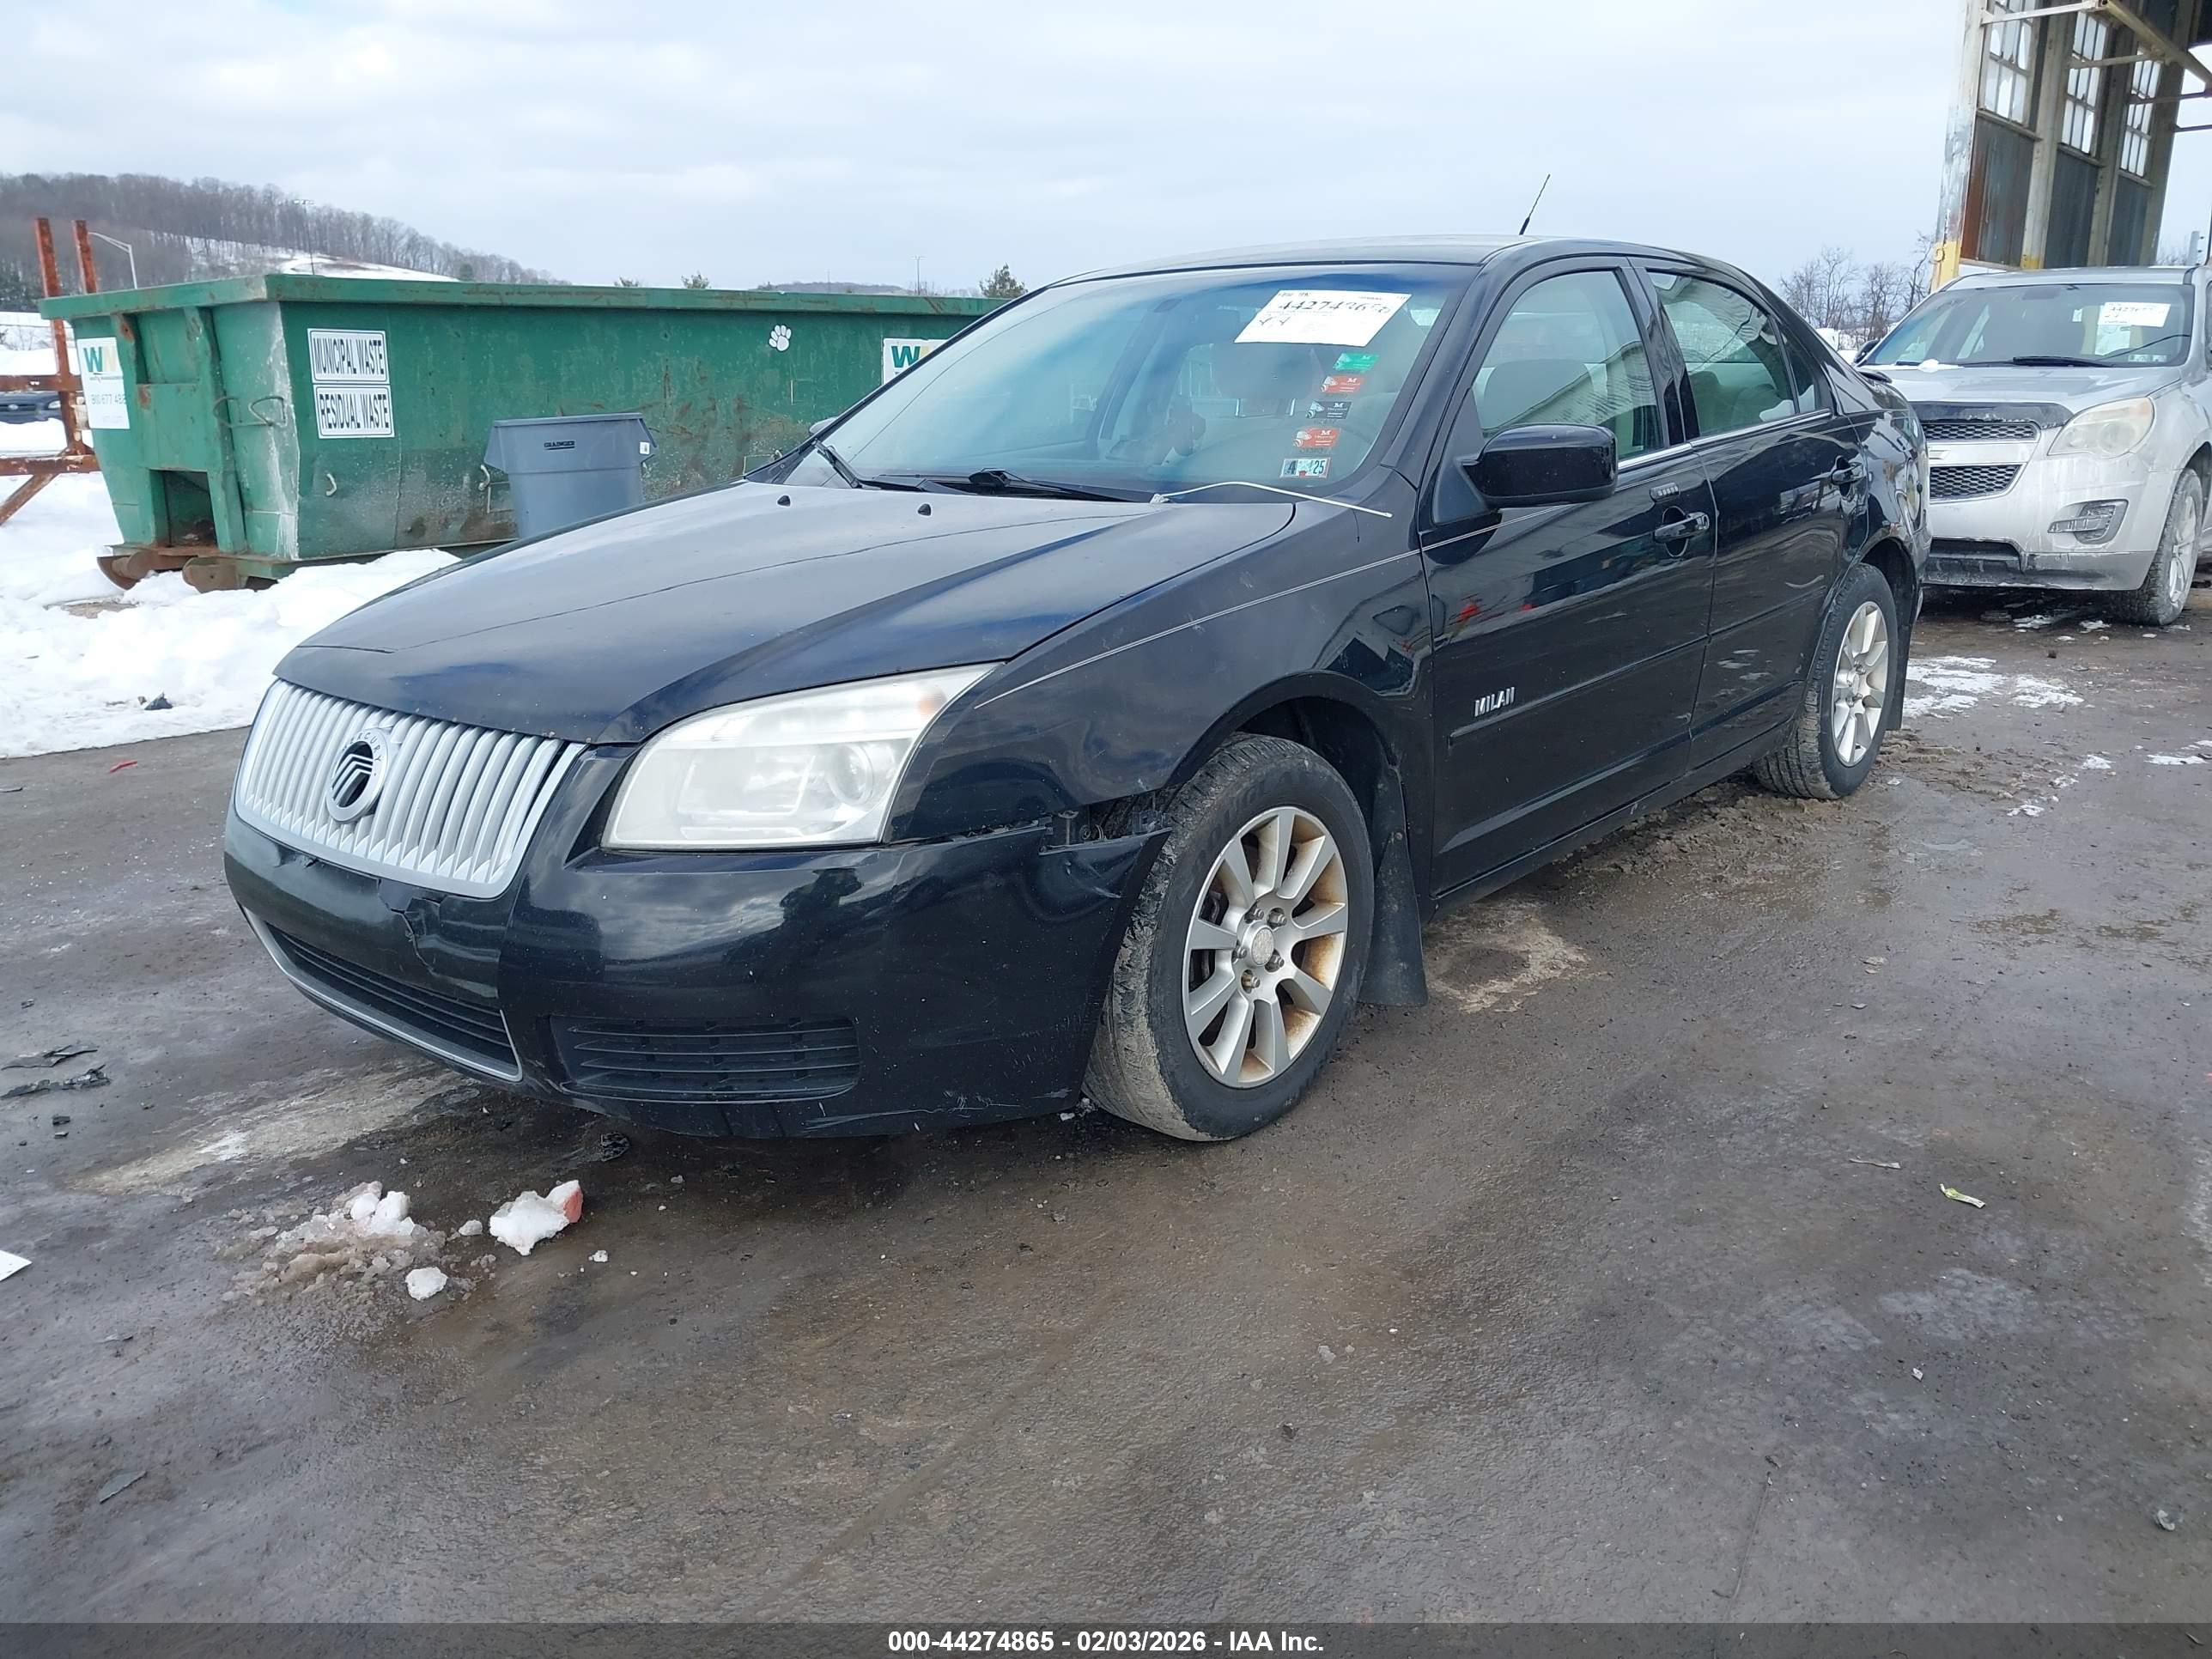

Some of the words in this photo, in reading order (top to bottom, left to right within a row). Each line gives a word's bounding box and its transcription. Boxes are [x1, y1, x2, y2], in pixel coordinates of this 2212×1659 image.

[313, 337, 356, 374] MUNICIPAL
[356, 338, 384, 374] WASTE
[319, 393, 361, 429] RESIDUAL
[361, 393, 389, 428] WASTE
[1474, 686, 1515, 717] MILAN
